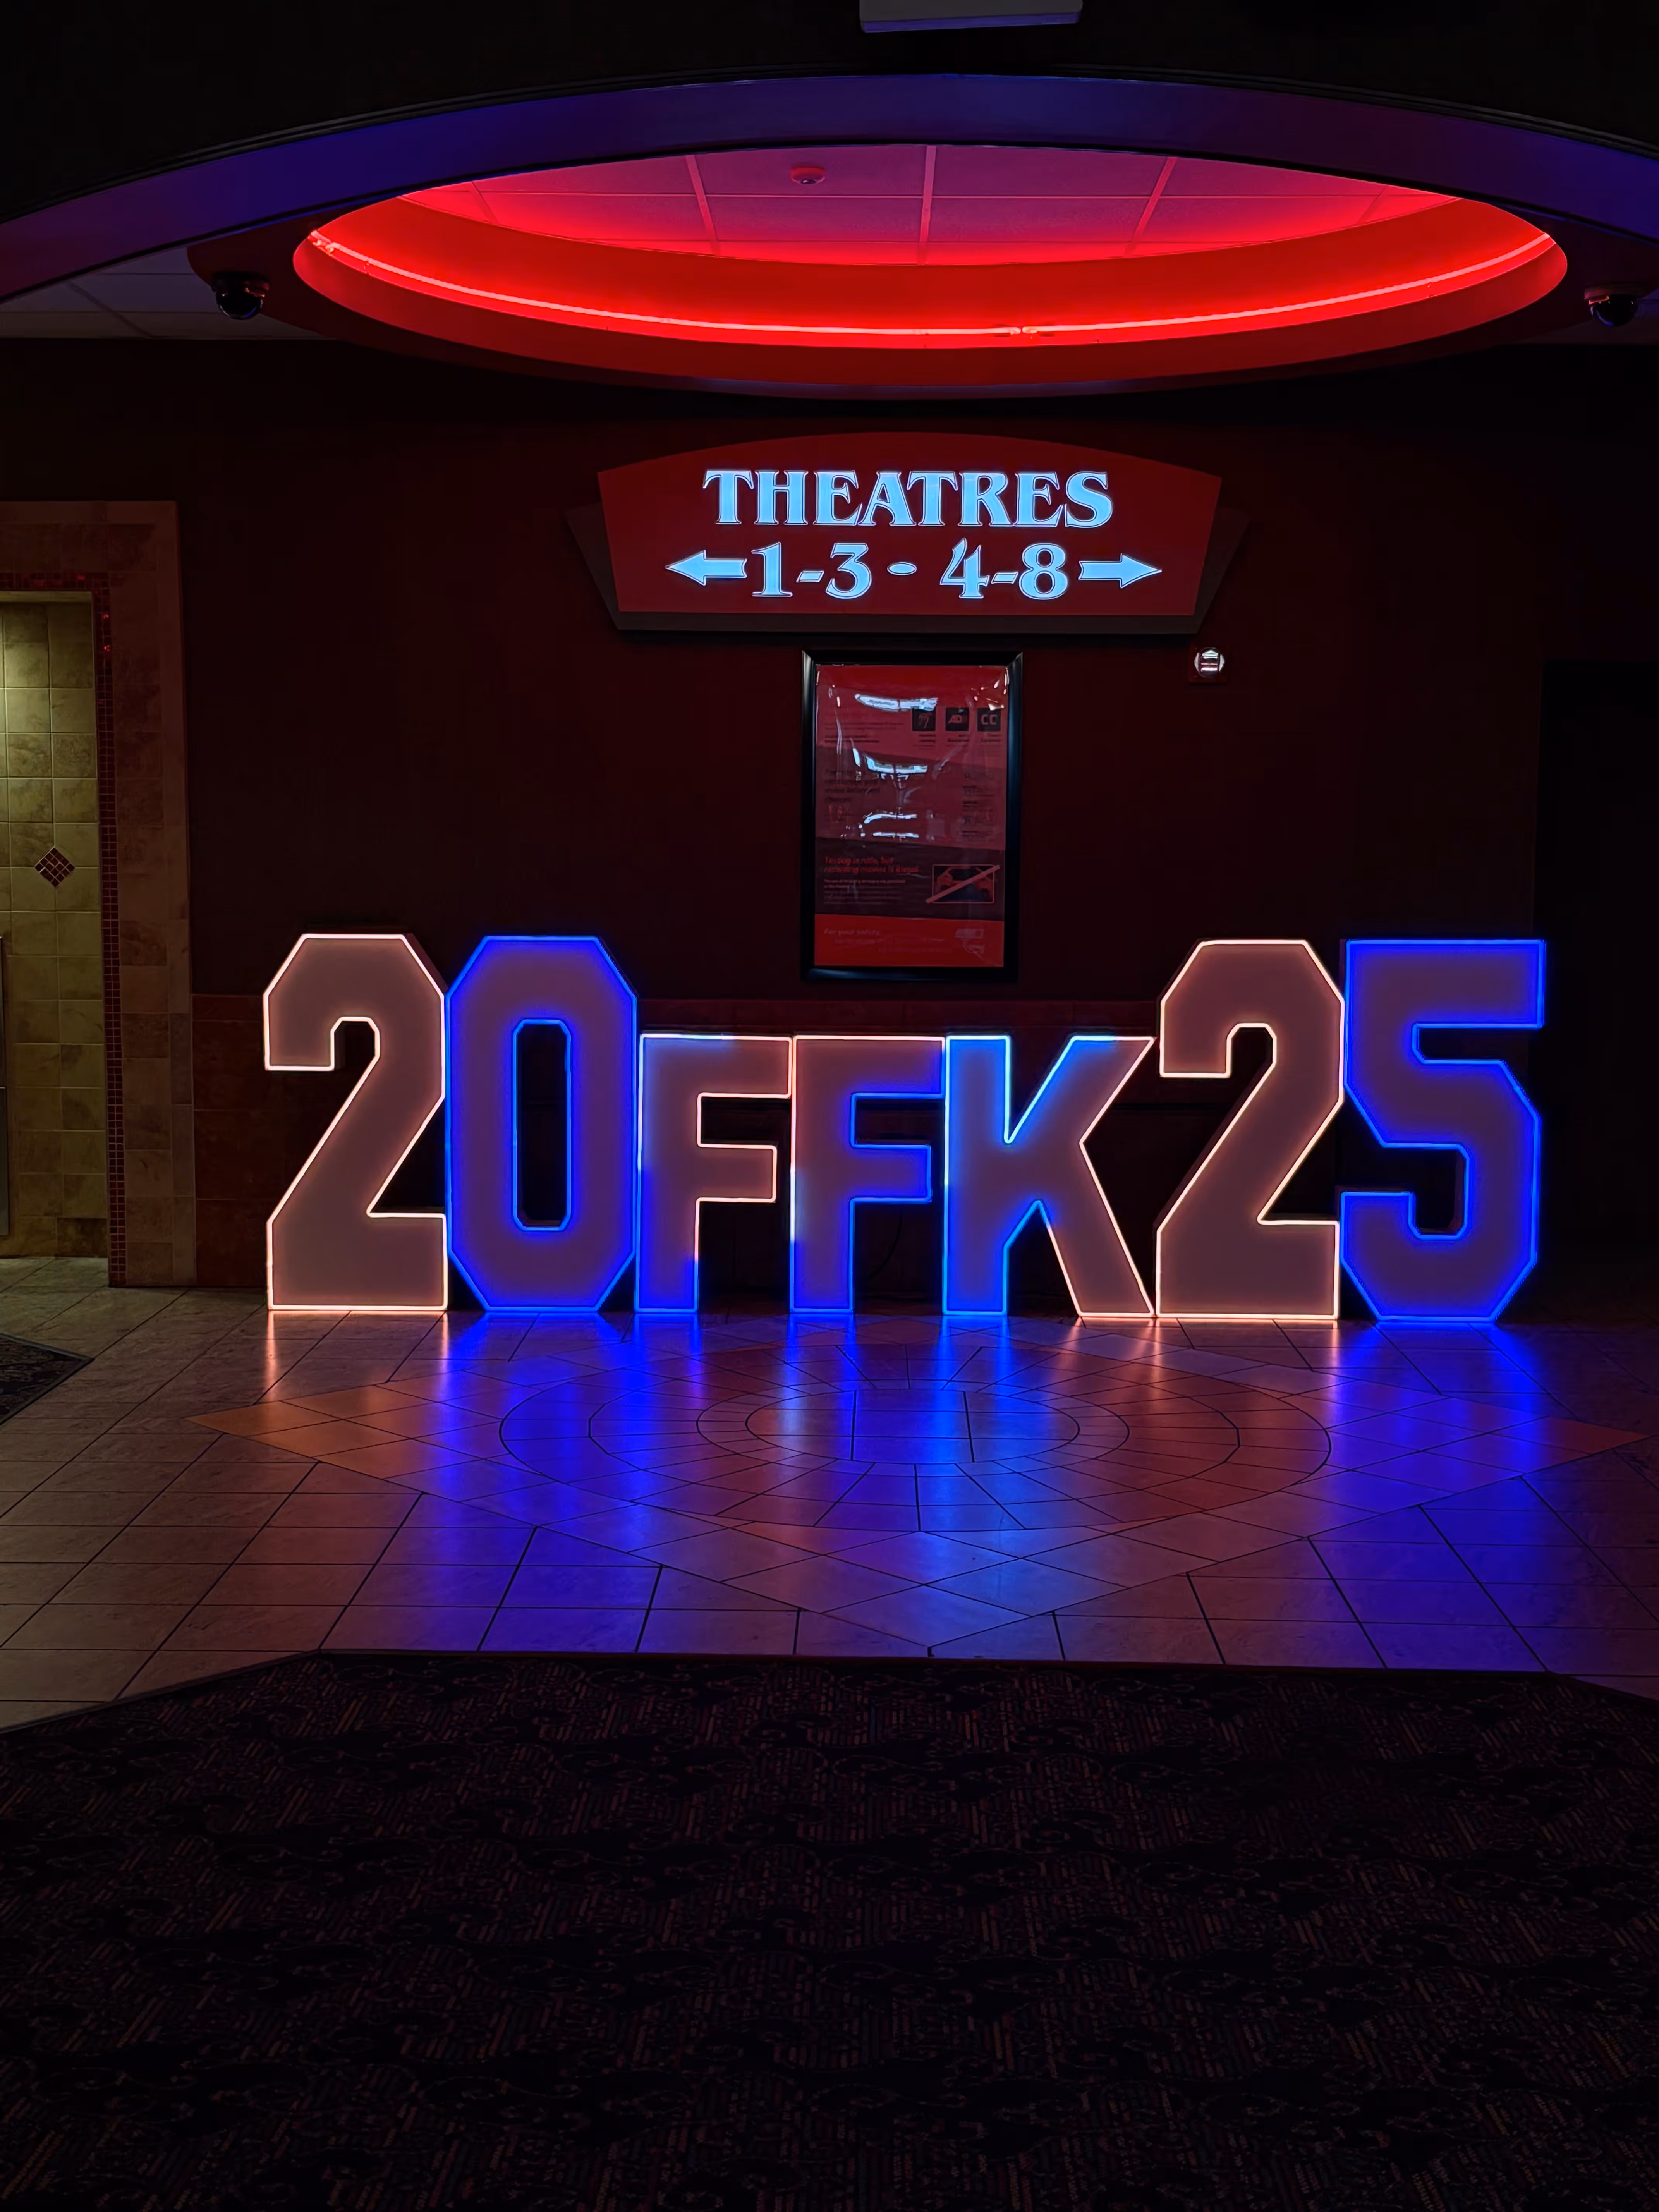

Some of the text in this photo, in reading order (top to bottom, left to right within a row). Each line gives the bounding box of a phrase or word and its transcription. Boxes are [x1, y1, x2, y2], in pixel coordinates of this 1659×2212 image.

[702, 469, 1114, 529] THEATRES
[750, 537, 1070, 601] 1-3 4-8
[981, 714, 998, 725] CC
[263, 932, 1547, 1323] 20FFK25
